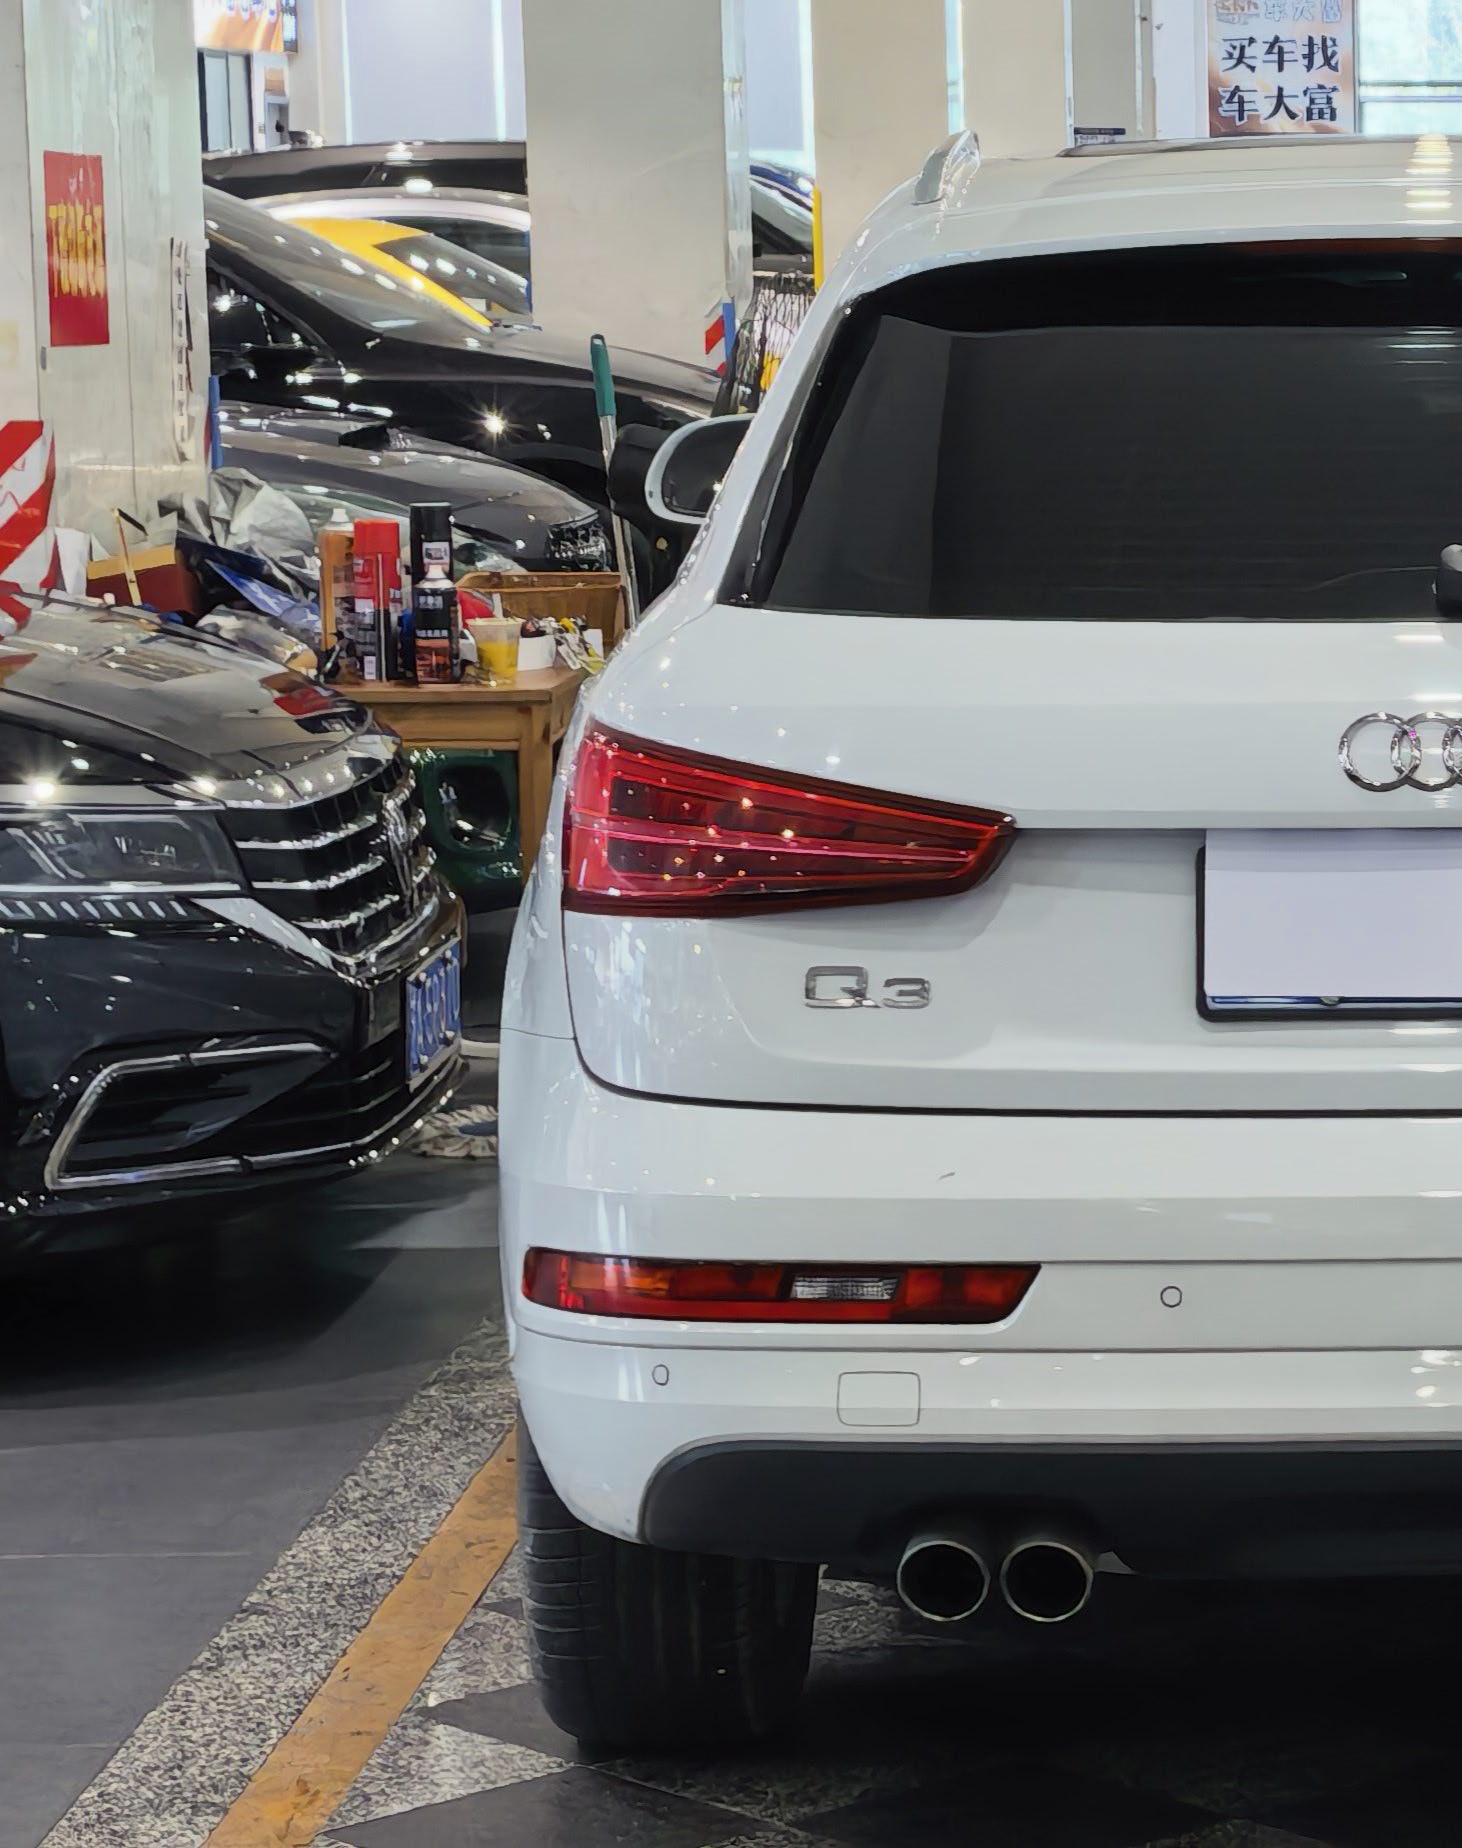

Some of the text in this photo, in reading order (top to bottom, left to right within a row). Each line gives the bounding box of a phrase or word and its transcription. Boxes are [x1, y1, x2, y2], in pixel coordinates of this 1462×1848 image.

[1221, 34, 1340, 73] 买车找
[1221, 83, 1340, 123] 车大富
[805, 966, 931, 1009] Q3
